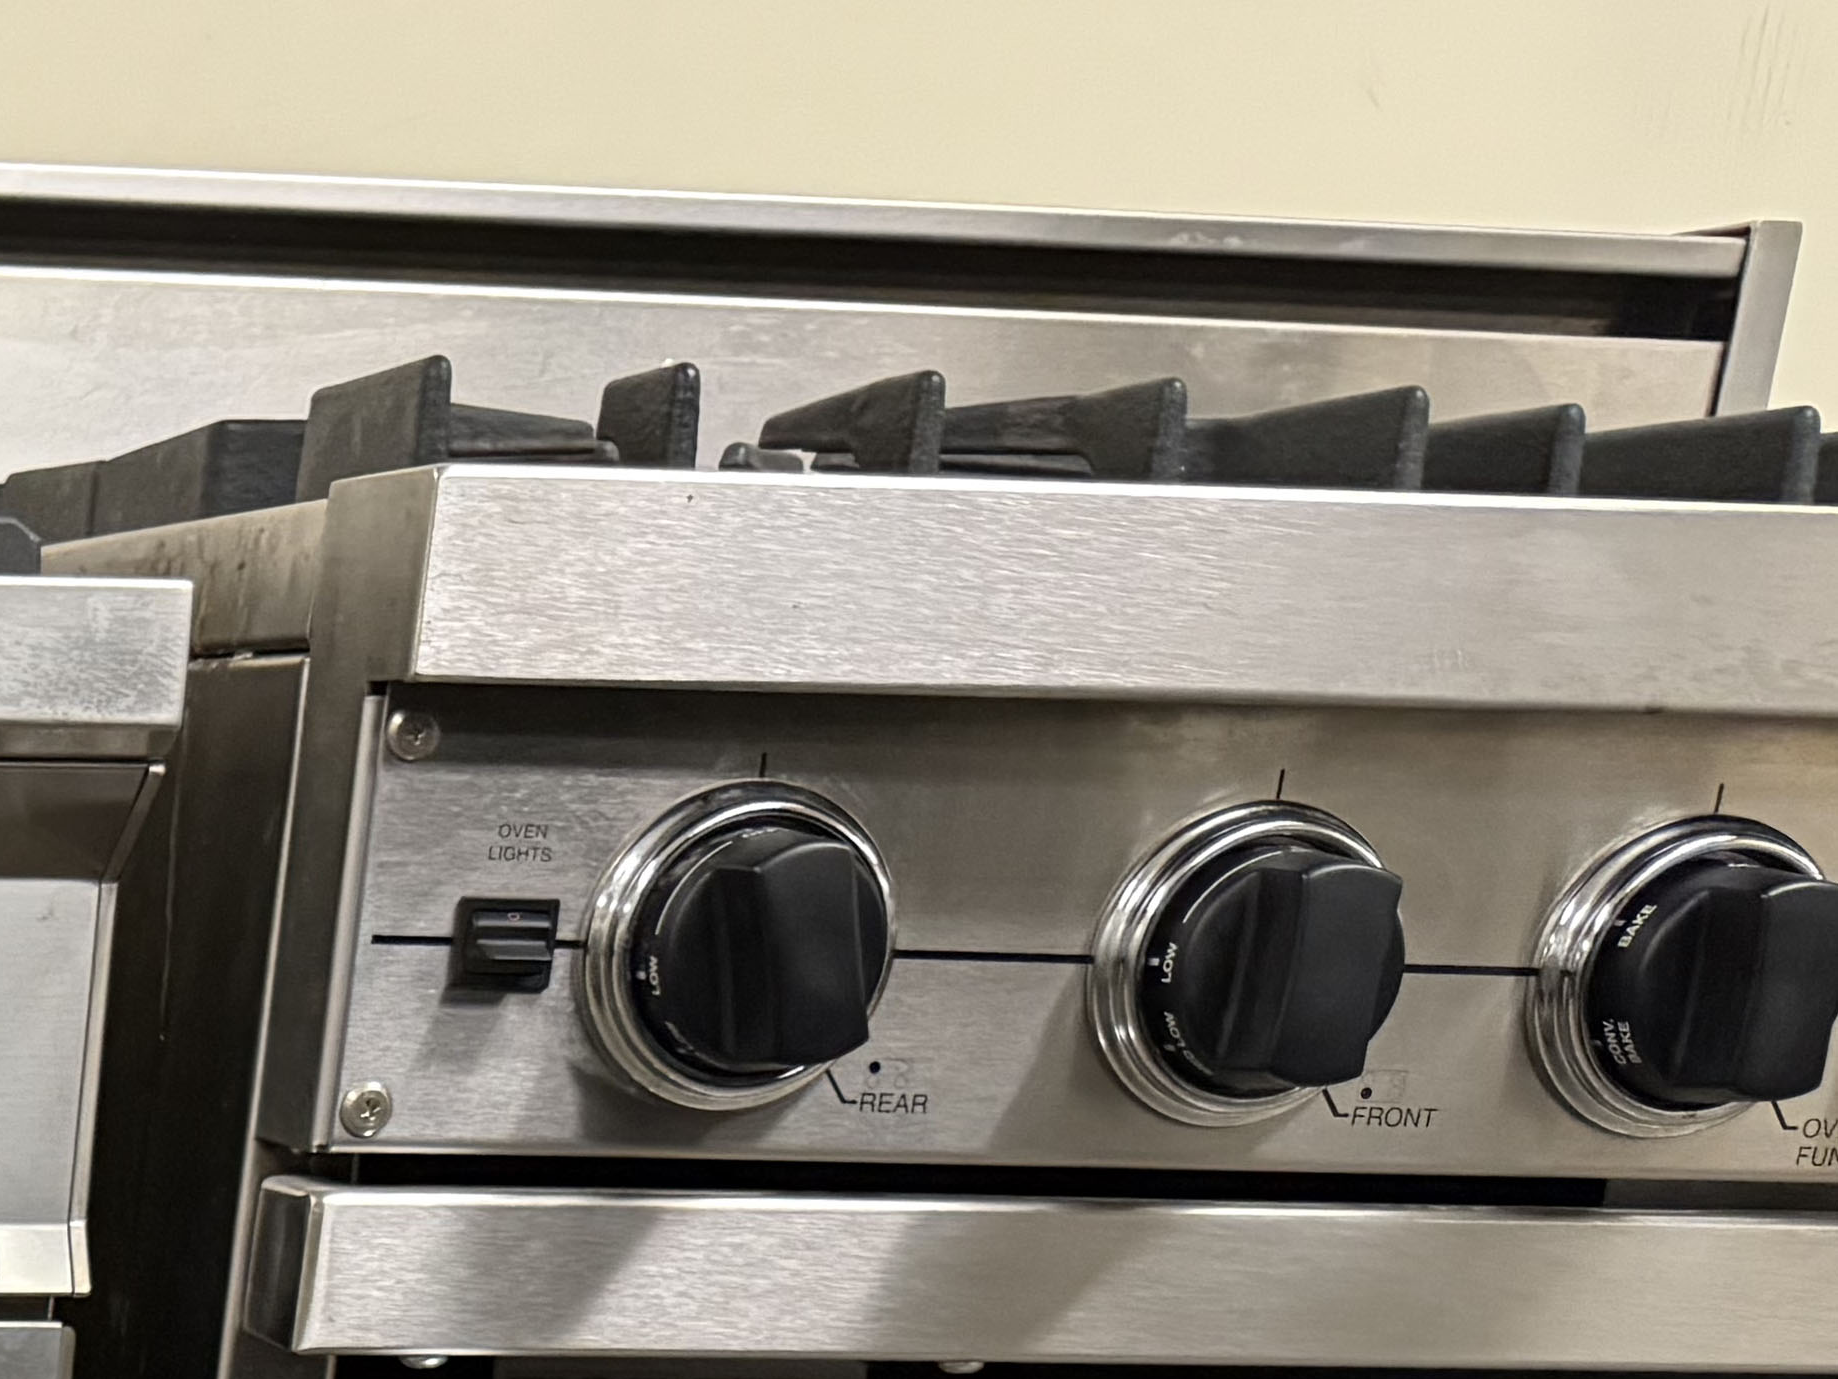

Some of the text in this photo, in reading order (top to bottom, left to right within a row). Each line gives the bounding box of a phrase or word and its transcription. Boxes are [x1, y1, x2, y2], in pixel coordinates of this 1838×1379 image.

[498, 824, 549, 839] OVEN
[488, 846, 552, 862] LIGHTS
[1617, 904, 1657, 948] BAKE
[1161, 942, 1178, 983] LOW
[649, 955, 661, 996] LOW
[859, 1092, 929, 1114] REAR
[1351, 1106, 1439, 1128] FRONT
